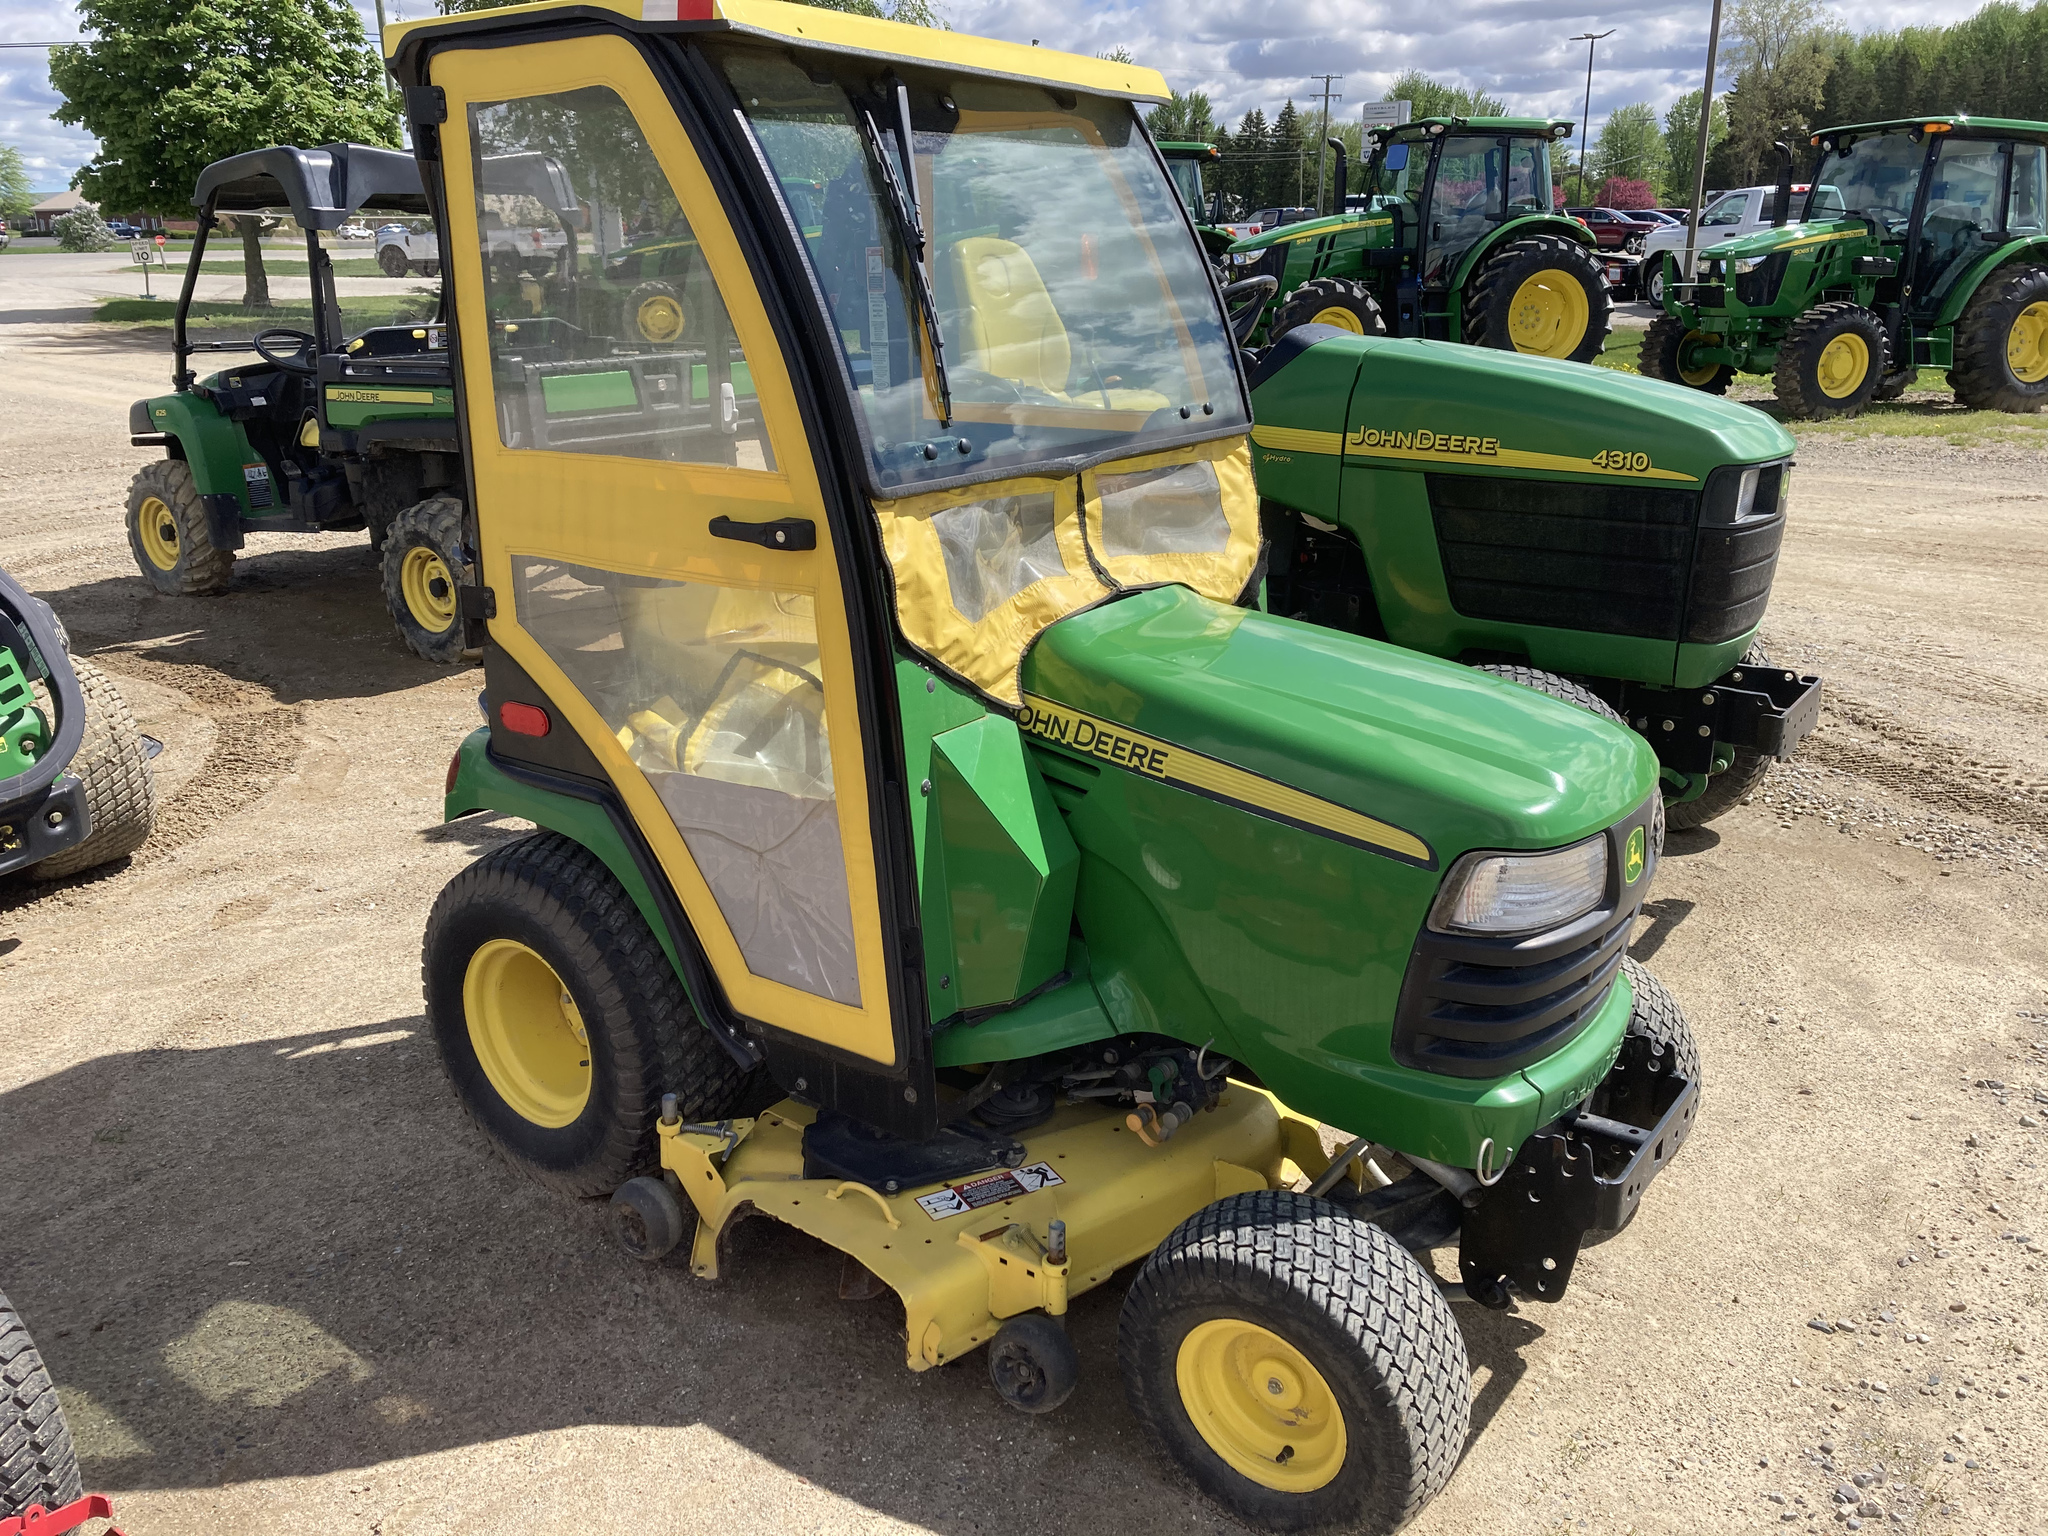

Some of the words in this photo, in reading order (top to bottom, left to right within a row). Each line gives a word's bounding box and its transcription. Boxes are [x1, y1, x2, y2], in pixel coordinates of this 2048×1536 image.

[136, 252, 149, 260] 10
[336, 391, 355, 400] JOHN
[355, 391, 380, 401] DEERE
[1351, 425, 1414, 449] JOHN
[1415, 429, 1498, 456] DEERE
[1592, 449, 1650, 472] 4310
[1014, 704, 1070, 741] OHN
[1072, 718, 1169, 775] DEERE
[970, 1174, 1005, 1188] DANGER
